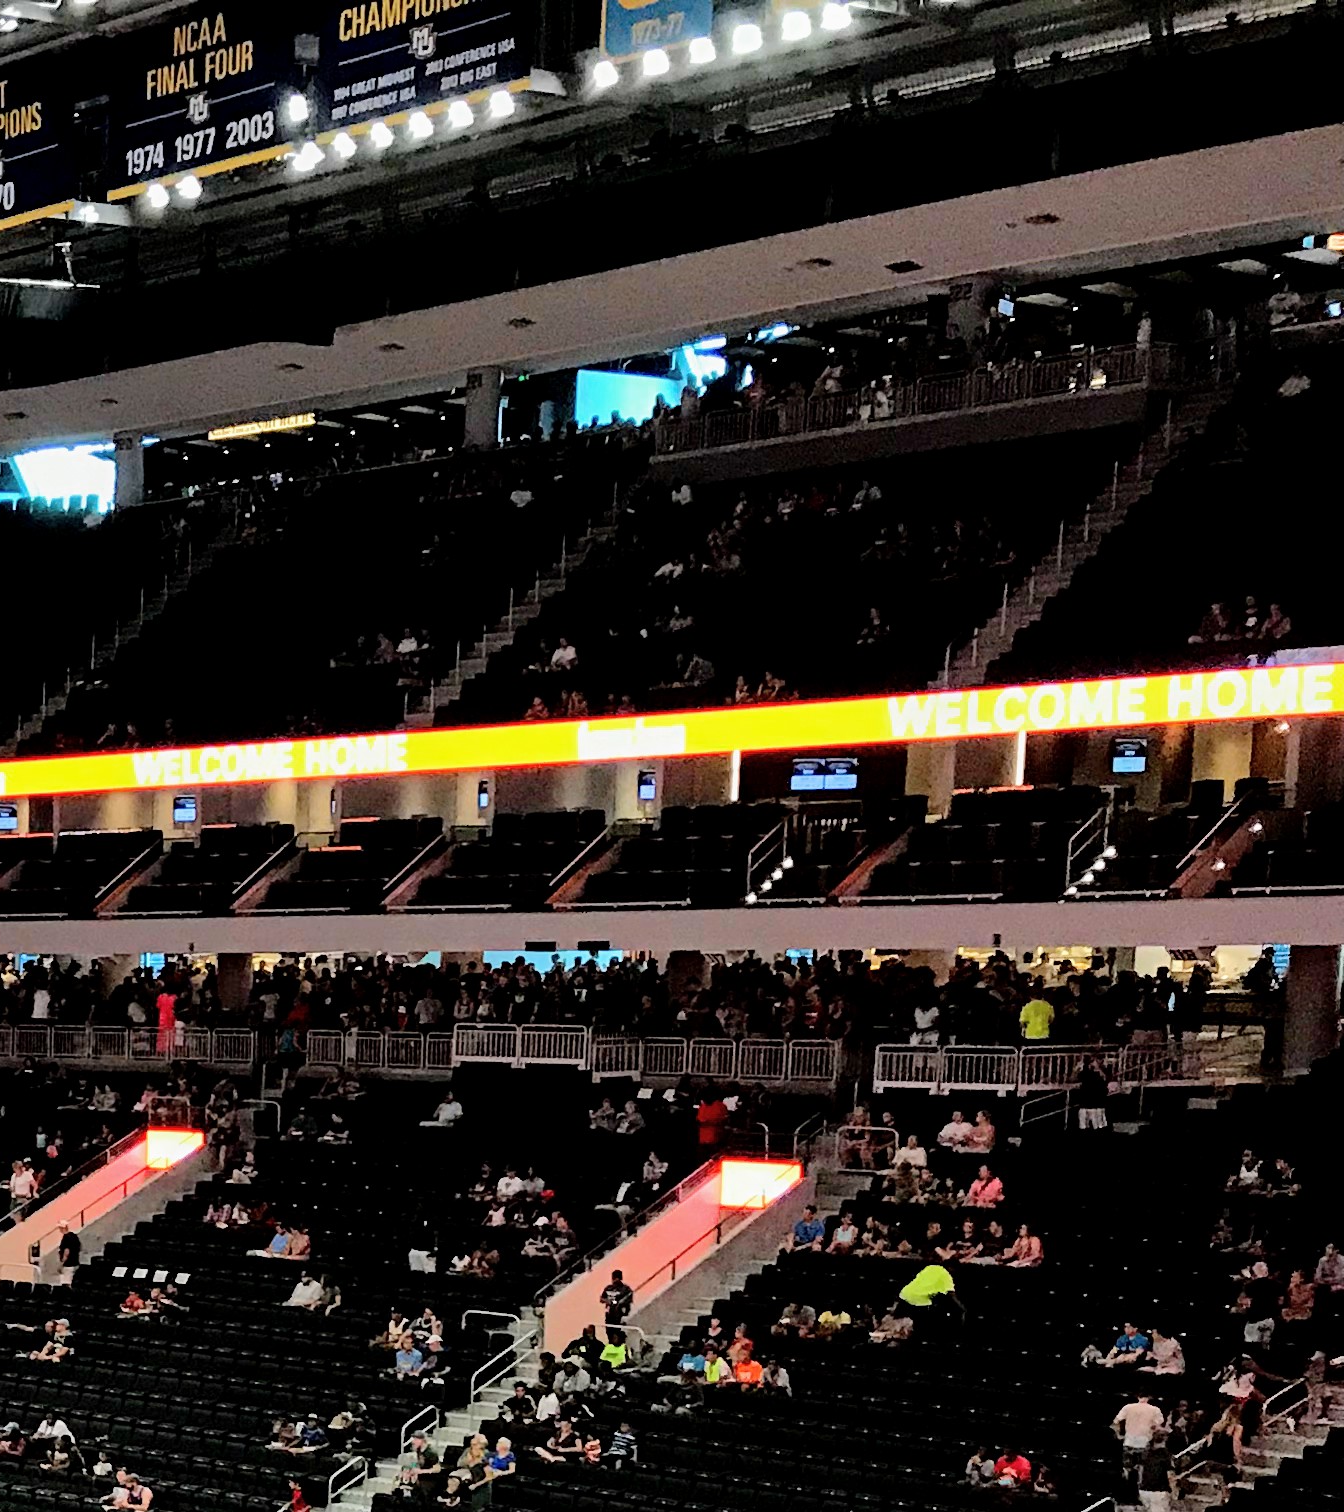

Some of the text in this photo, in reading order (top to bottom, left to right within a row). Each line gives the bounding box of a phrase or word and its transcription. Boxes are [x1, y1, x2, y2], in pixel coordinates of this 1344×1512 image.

[173, 12, 227, 57] NCAA
[146, 40, 254, 100] FINAL FOUR
[476, 62, 497, 80] EAST
[126, 110, 275, 176] 1974 1977 2003
[888, 665, 1334, 737] WELCOME HOME
[132, 733, 408, 785] WELCOME HOME
